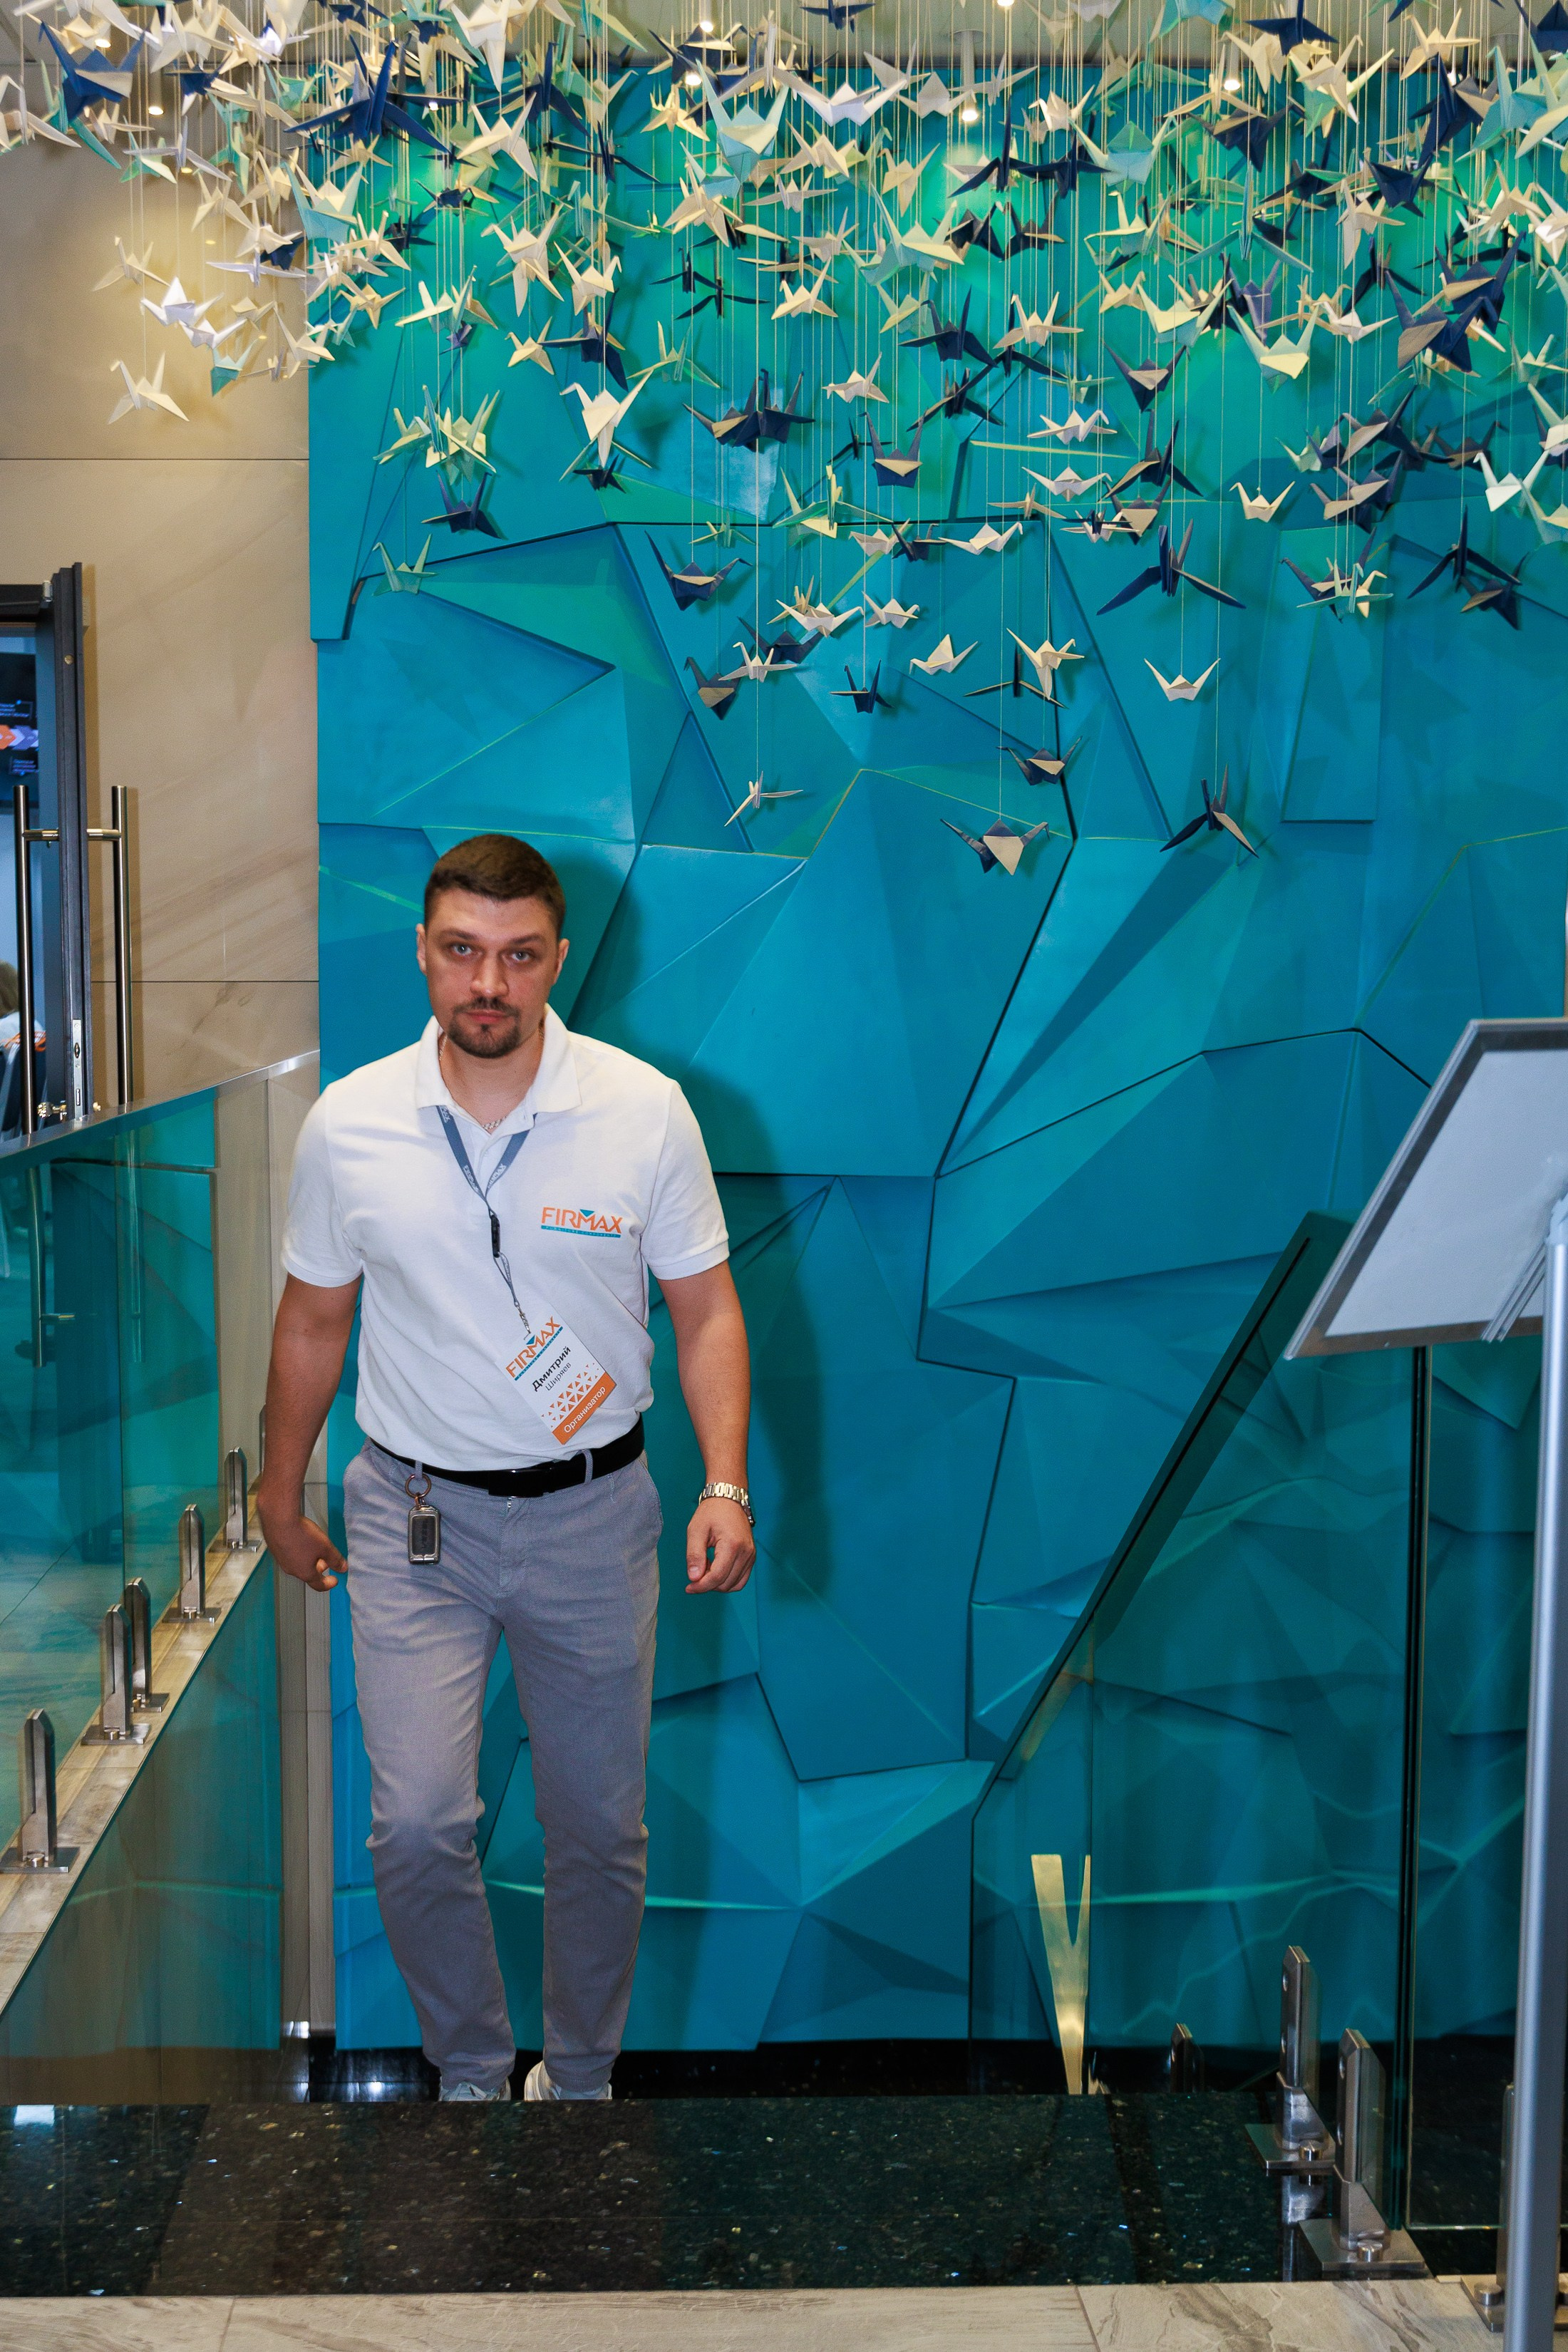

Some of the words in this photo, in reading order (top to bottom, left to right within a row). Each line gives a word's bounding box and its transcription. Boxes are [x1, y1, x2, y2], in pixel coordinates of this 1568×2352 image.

[542, 1207, 623, 1234] FIRMAX
[505, 1316, 561, 1378] FIRMAX
[532, 1346, 572, 1392] Дмитрий
[545, 1362, 572, 1391] Ширяев
[564, 1386, 606, 1433] Организатор
